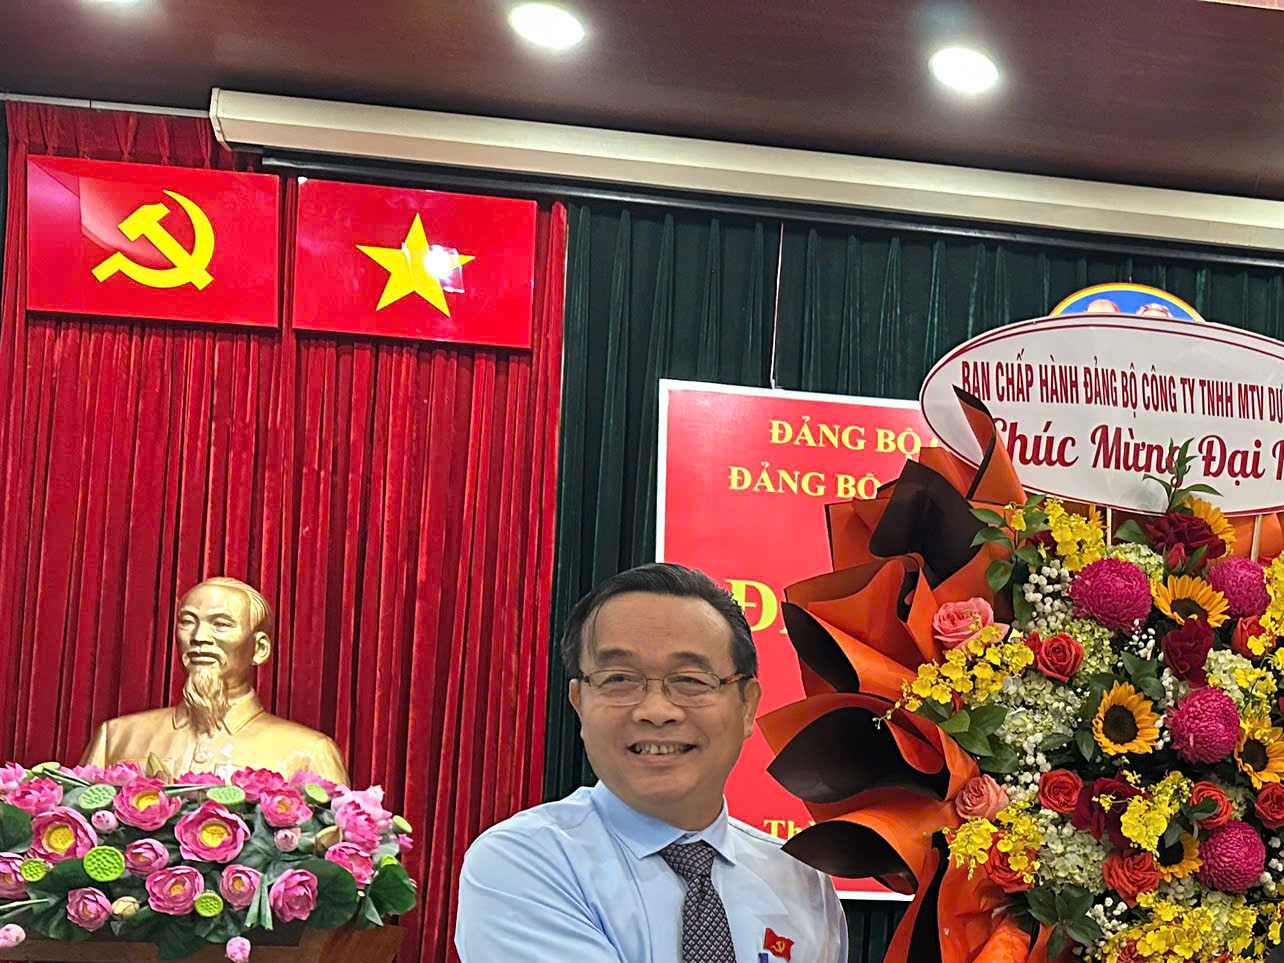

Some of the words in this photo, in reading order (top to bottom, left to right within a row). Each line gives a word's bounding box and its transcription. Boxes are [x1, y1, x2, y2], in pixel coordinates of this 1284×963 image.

[961, 361, 990, 401] BAN
[995, 348, 1034, 402] CHẤP
[1039, 354, 1080, 404] HÀNH
[1083, 356, 1118, 407] ĐẢNG
[1120, 362, 1138, 418] BỘ
[1141, 364, 1178, 413] CÔNG
[1180, 377, 1195, 414] TY
[1199, 379, 1234, 418] TNHH
[1237, 383, 1264, 420] MTV
[769, 416, 866, 451] ĐẢNG
[728, 461, 826, 497] ĐẢNG
[1198, 434, 1266, 487] Đại
